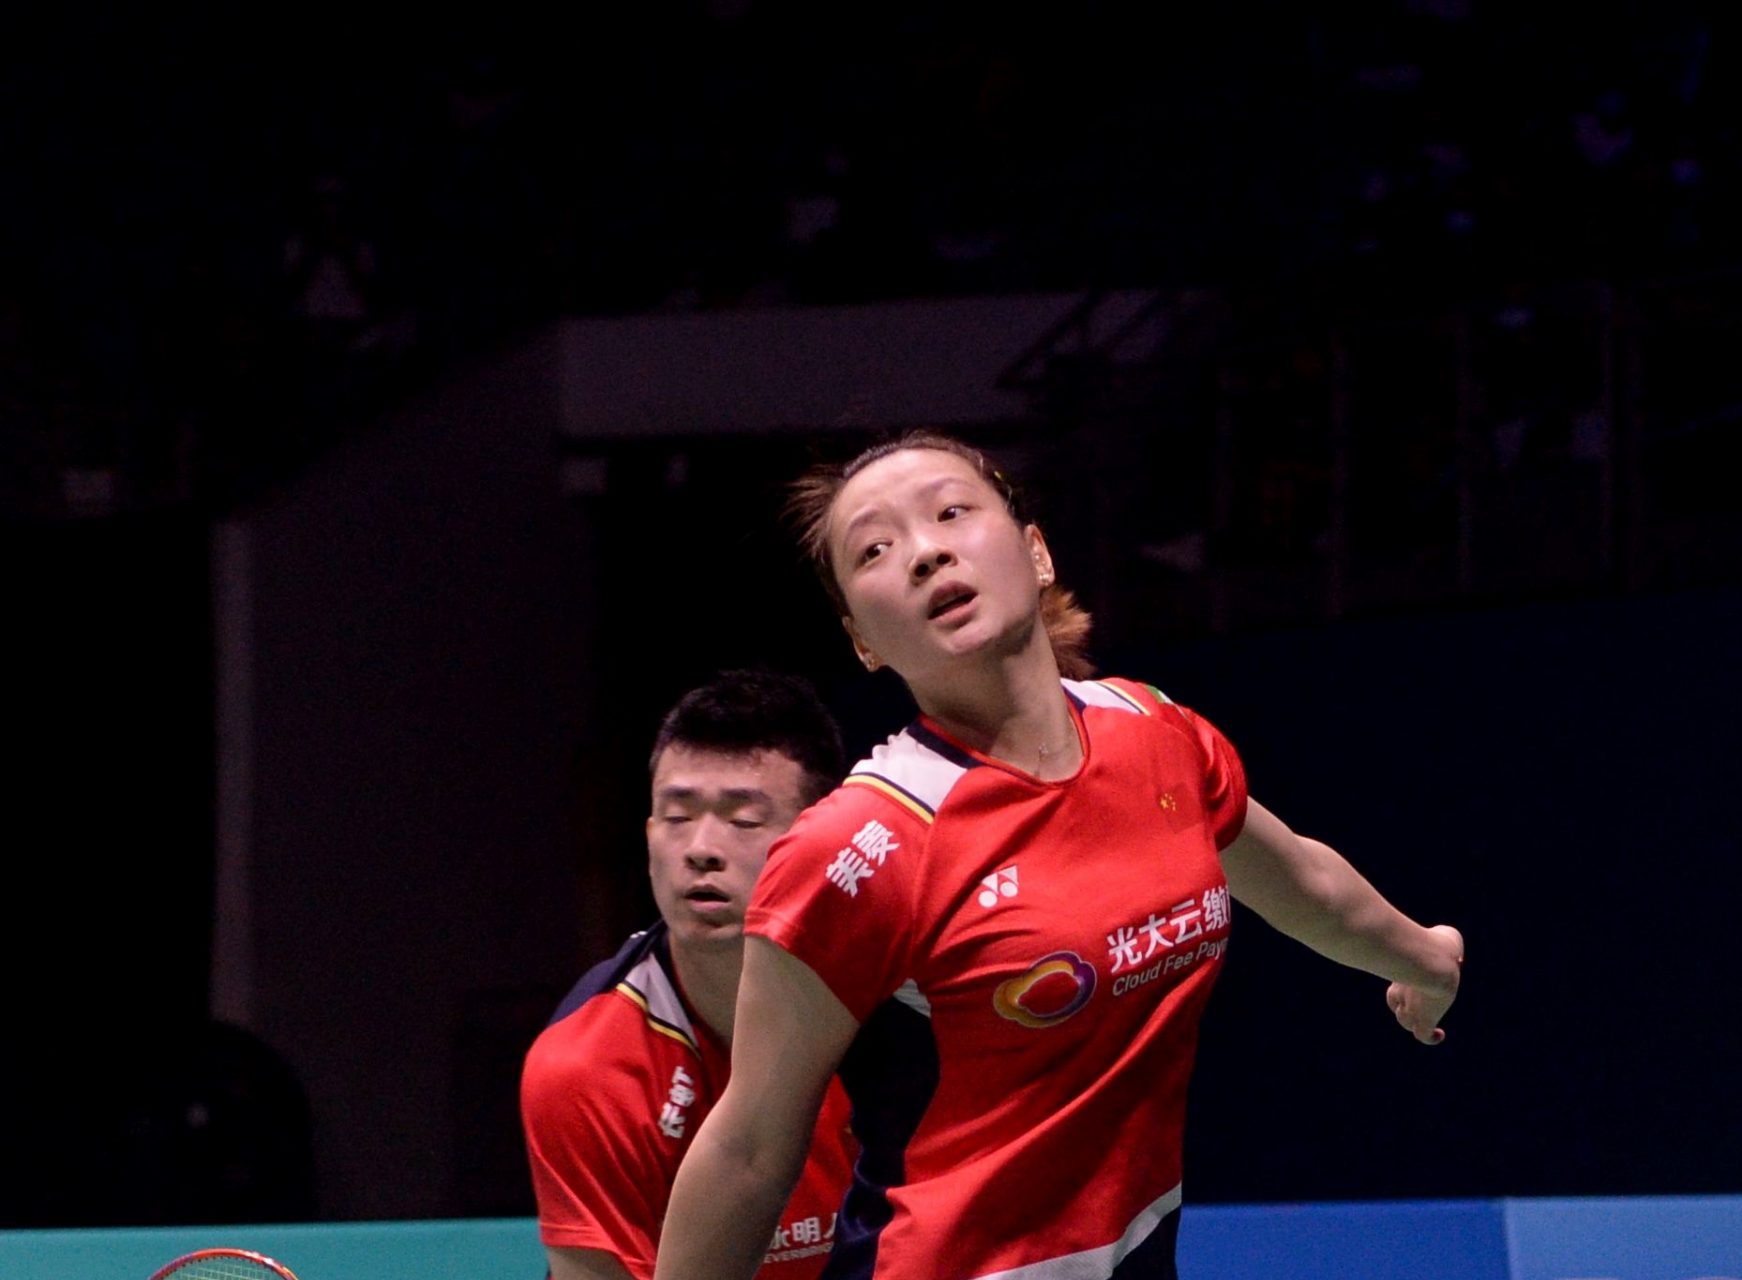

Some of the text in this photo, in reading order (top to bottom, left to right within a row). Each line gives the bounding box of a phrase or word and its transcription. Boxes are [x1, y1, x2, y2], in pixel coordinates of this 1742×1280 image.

[825, 818, 900, 898] 美菱
[1106, 885, 1231, 973] 光大云缴
[1112, 962, 1162, 997] Cloud
[1163, 951, 1194, 975] Fee
